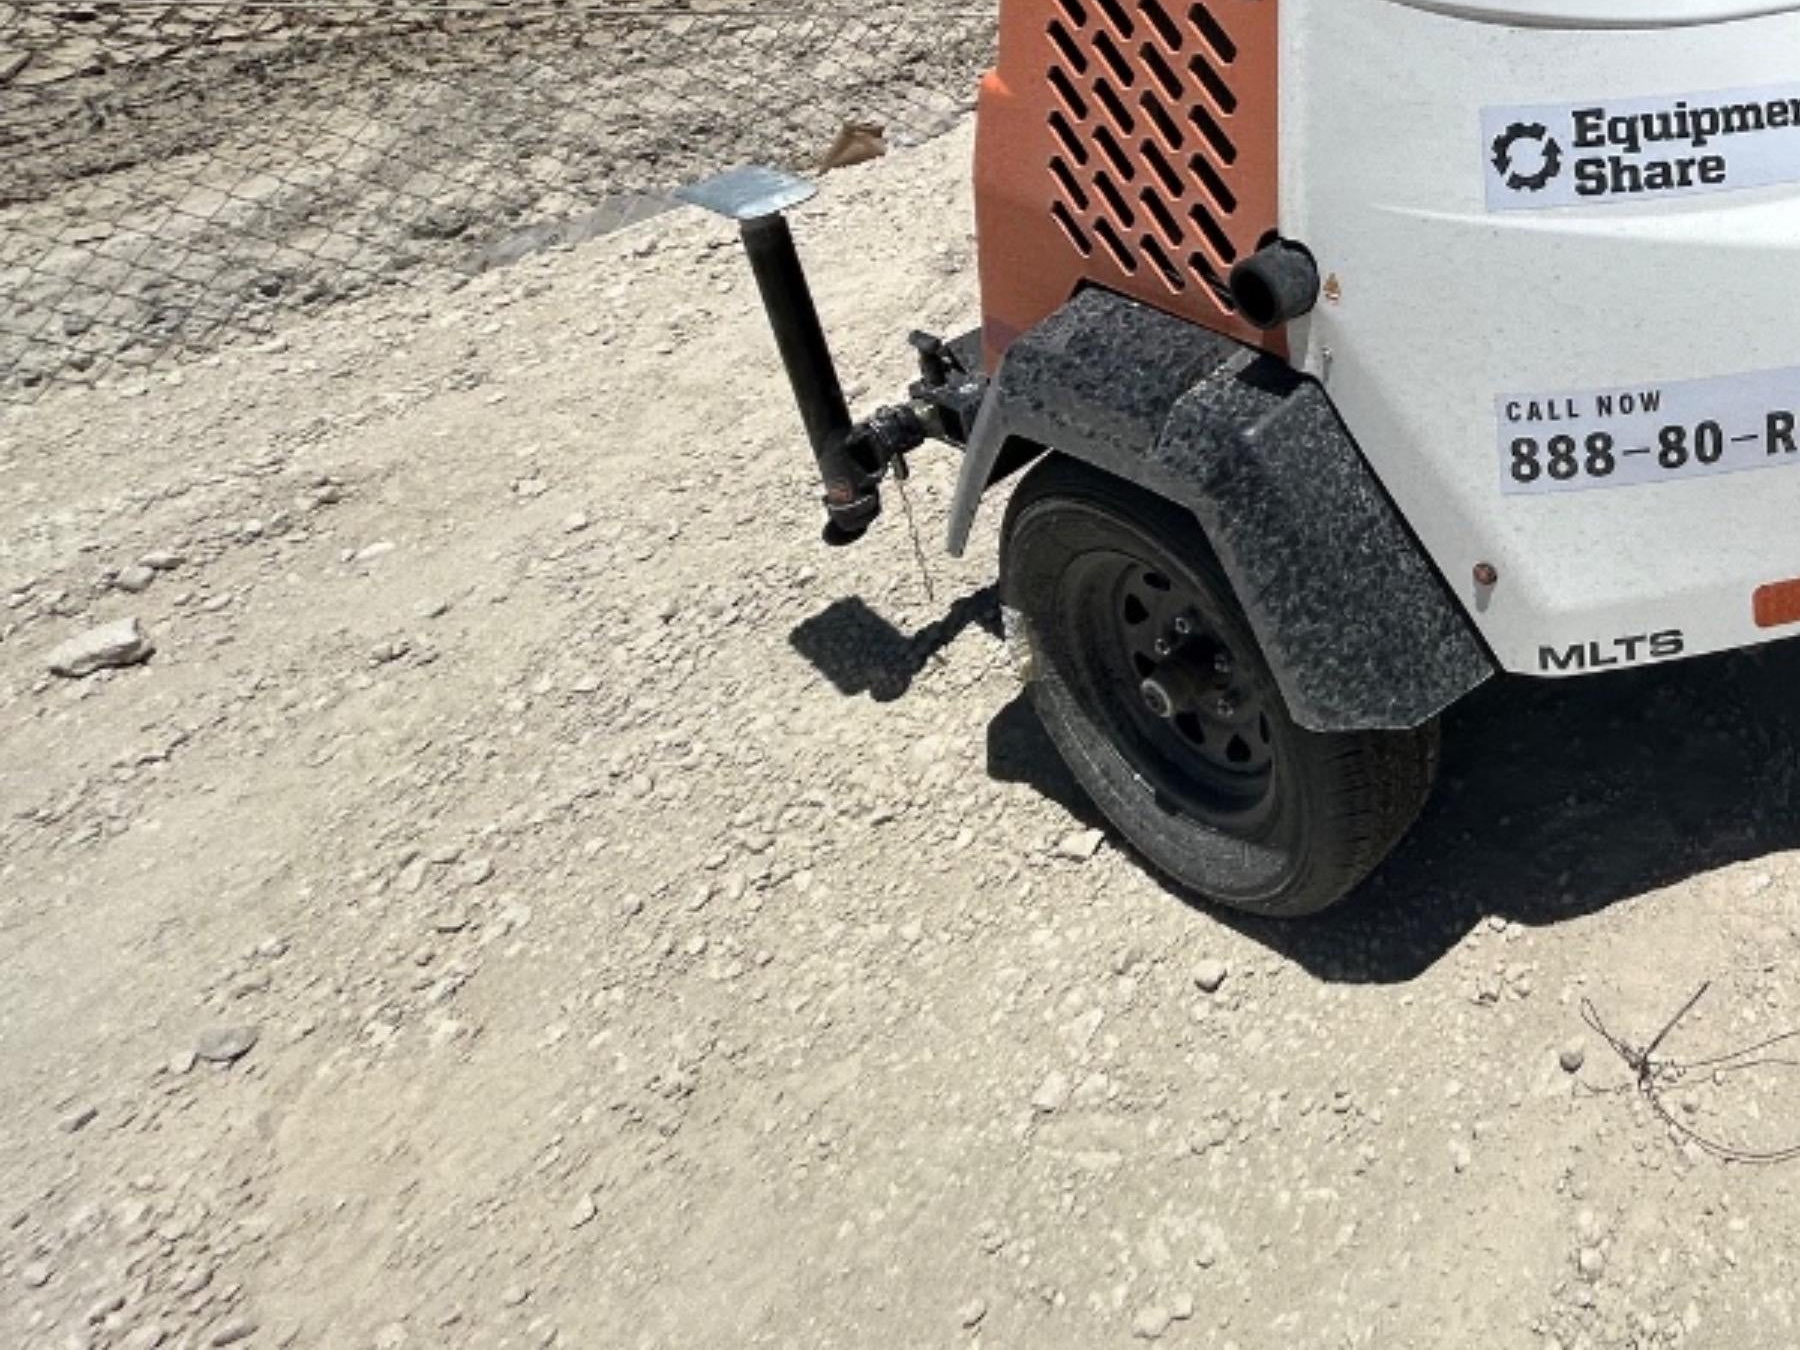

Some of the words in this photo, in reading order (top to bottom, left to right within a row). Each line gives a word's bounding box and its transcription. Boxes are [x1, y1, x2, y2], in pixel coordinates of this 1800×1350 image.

[1574, 154, 1726, 196] Share
[1505, 398, 1581, 422] CALL
[1596, 390, 1662, 418] NOW
[1538, 629, 1684, 670] MLTS
